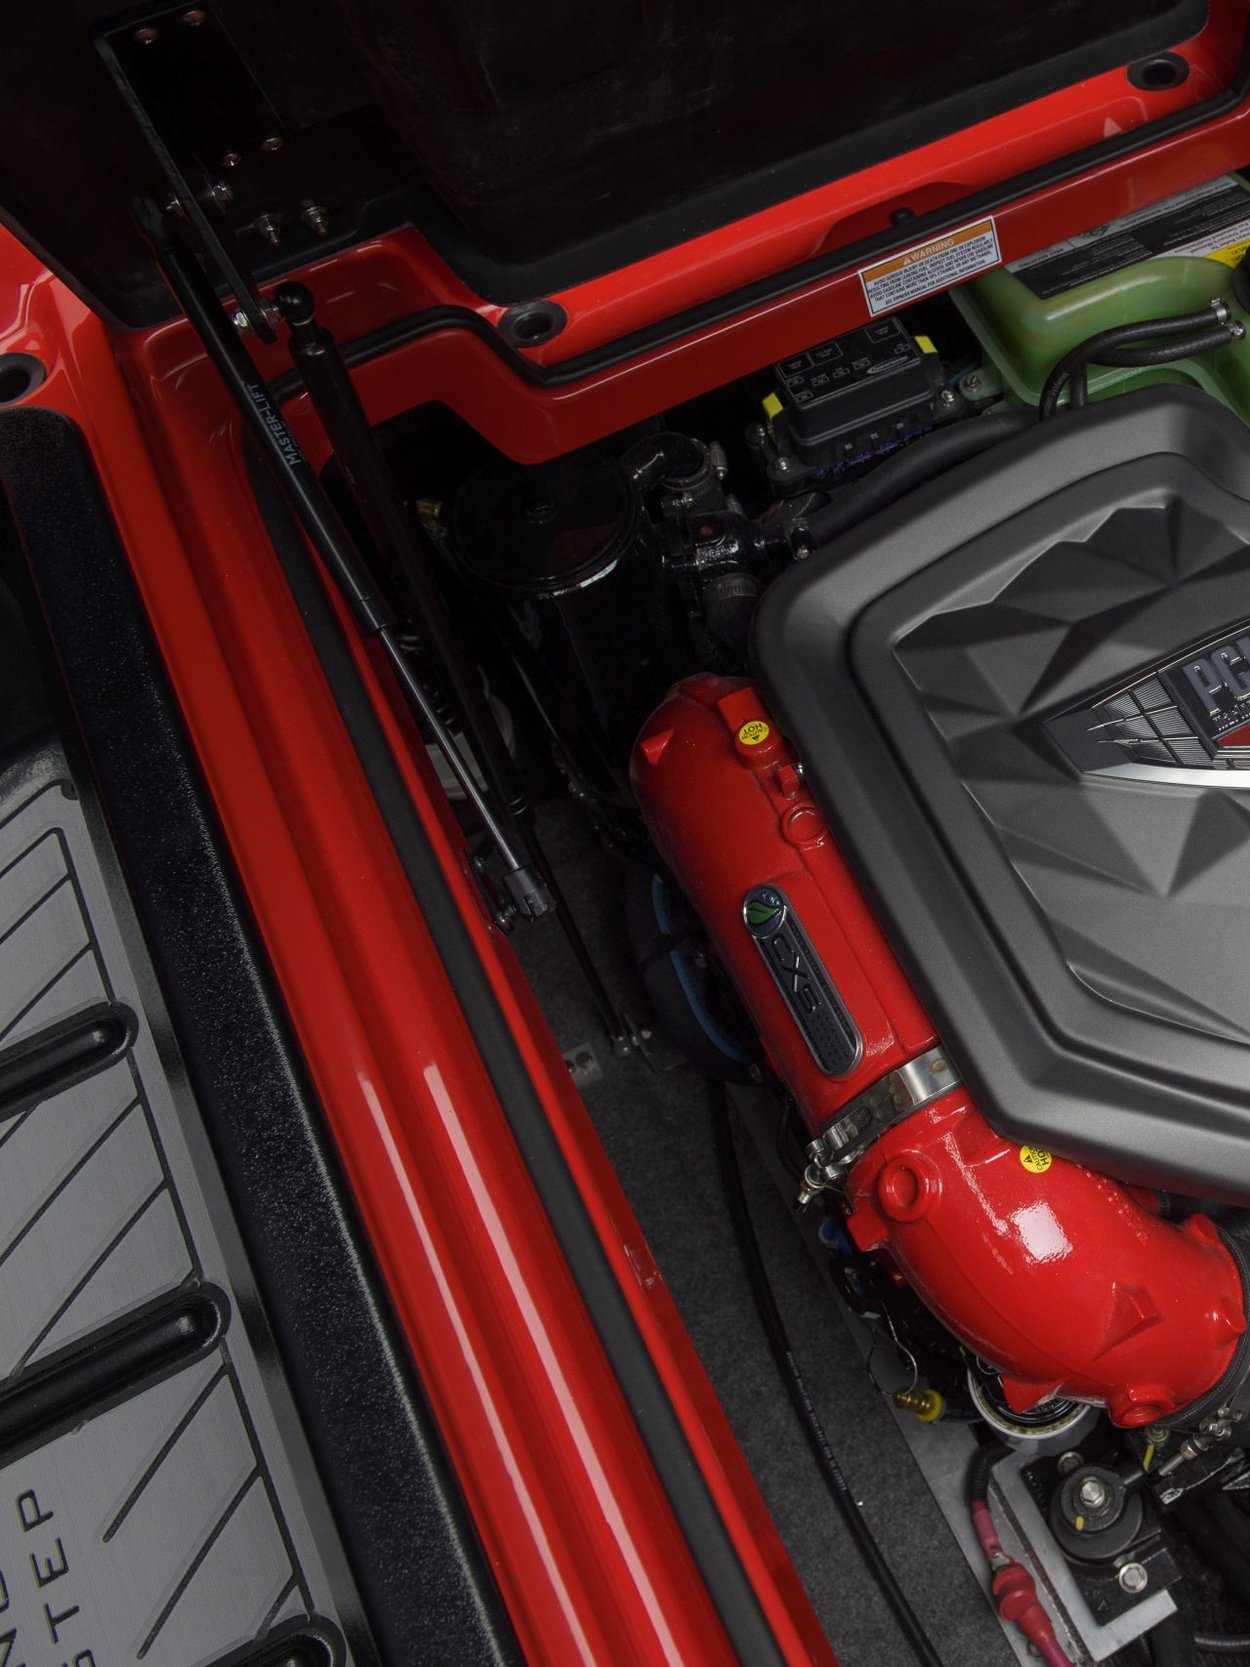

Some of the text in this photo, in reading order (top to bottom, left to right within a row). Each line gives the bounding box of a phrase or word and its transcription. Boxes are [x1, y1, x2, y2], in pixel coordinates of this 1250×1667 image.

[873, 277, 885, 285] AVOID
[886, 270, 902, 280] SERIOUS
[903, 263, 917, 273] INJURY
[924, 255, 937, 264] DEATH
[938, 250, 949, 258] FROM
[964, 235, 985, 247] EXPLOSION
[910, 237, 954, 261] WARNING
[867, 281, 888, 294] RESULTING
[889, 276, 900, 284] FROM
[901, 269, 918, 279] LEAKING
[929, 258, 945, 267] INSPECT
[945, 253, 955, 261] FUEL
[955, 247, 970, 256] SYSTEM
[869, 289, 882, 298] AVOID
[882, 281, 901, 293] GASOLINE
[902, 271, 926, 285] CONTAINING
[953, 254, 966, 263] NEVER
[974, 243, 992, 254] GASOLINE
[874, 294, 885, 302] THAT
[885, 285, 905, 297] CONTAINS
[905, 280, 916, 289] MORE
[917, 275, 928, 283] THAN
[937, 264, 954, 275] ETHANOL
[909, 283, 927, 294] MANUAL
[935, 270, 957, 283] ADDITIONAL
[248, 383, 300, 465] MASTER-LIFT
[741, 728, 768, 740] CAUTION
[743, 723, 763, 735] HOT
[772, 933, 822, 1014] CXS
